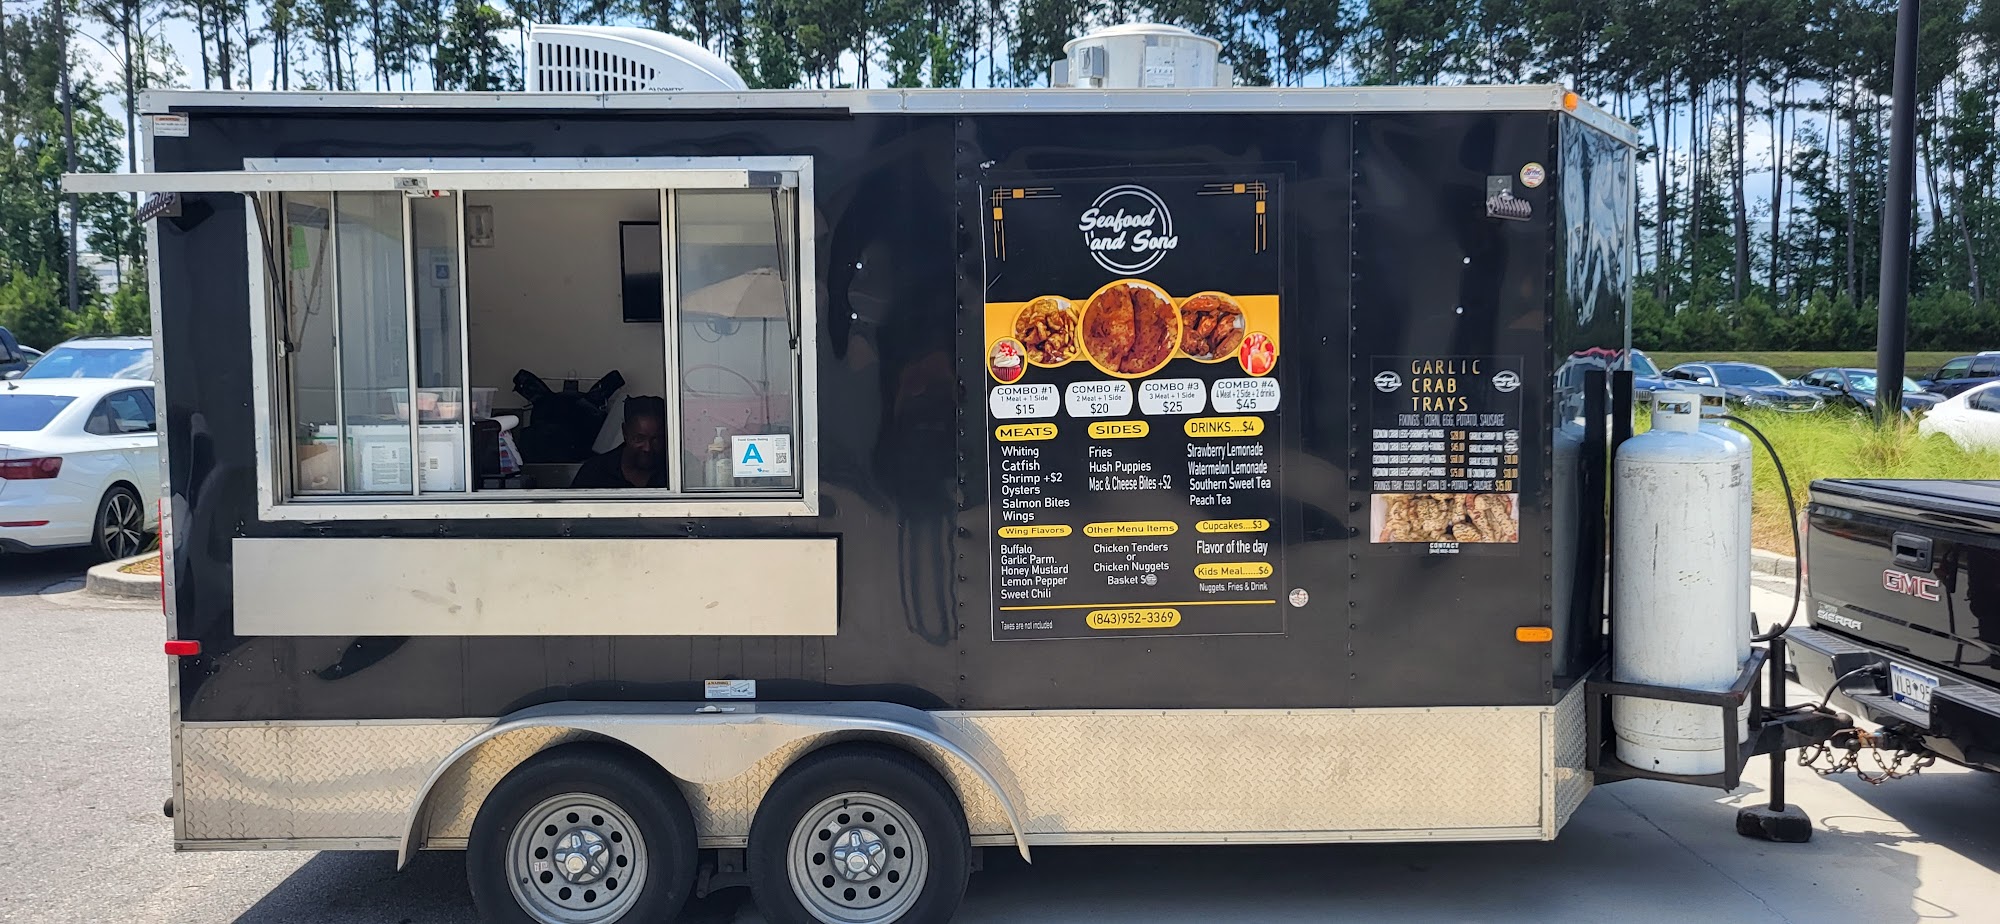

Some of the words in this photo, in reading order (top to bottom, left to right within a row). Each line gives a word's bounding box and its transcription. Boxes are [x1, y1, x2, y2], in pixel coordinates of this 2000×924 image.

[1079, 208, 1156, 232] Seafood
[1090, 231, 1126, 250] and
[1130, 229, 1178, 252] Sons
[1412, 360, 1480, 374] GARLIC
[998, 387, 1038, 395] COMBO
[1072, 385, 1111, 393] COMBO
[1145, 383, 1184, 391] COMBO
[1218, 381, 1257, 389] COMBO
[1412, 378, 1456, 393] CRAB
[1015, 404, 1035, 415] $15
[1090, 403, 1108, 415] $20
[1162, 401, 1182, 413] $25
[1236, 399, 1257, 410] $45
[1412, 397, 1468, 412] TRAYS
[1480, 414, 1504, 426] SAUSAGE
[1000, 427, 1053, 437] MEATS
[1096, 425, 1142, 434] SIDES
[742, 444, 764, 463] A
[1001, 446, 1039, 458] Whiting
[1089, 446, 1112, 458] Fries
[1187, 442, 1225, 460] Strawberry
[1227, 442, 1263, 456] Lemonade
[1002, 460, 1040, 471] Catfish
[1089, 461, 1112, 472] Hush
[1115, 460, 1151, 474] Puppies
[1188, 460, 1230, 475] Watermelon
[1231, 459, 1267, 474] Lemonade
[1002, 474, 1040, 485] Shrimp
[1044, 472, 1062, 483] +$2
[1089, 477, 1103, 491] Mac
[1105, 476, 1110, 490] &
[1112, 476, 1137, 490] Cheese
[1139, 475, 1156, 490] Bites
[1190, 478, 1227, 490] Southern
[1229, 477, 1254, 489] Sweet
[1256, 476, 1271, 488] Tea
[1002, 485, 1040, 497] Oysters
[1003, 499, 1041, 508] Salmon
[1045, 497, 1070, 507] Bites
[1190, 494, 1214, 505] Peach
[1216, 494, 1232, 504] Tea
[1003, 511, 1034, 523] Wings
[1001, 544, 1032, 554] Buffalo
[1094, 544, 1129, 553] Chicken
[1132, 543, 1168, 552] Tenders
[1196, 540, 1224, 554] Flavor
[1226, 540, 1235, 553] of
[1236, 540, 1250, 553] the
[1253, 539, 1268, 556] day
[1001, 555, 1027, 564] Garlic
[1030, 555, 1057, 564] Parm.
[1001, 566, 1029, 577] Honey
[1032, 564, 1069, 574] Mustard
[1094, 563, 1129, 572] Chicken
[1132, 562, 1169, 572] Nuggets
[1002, 577, 1032, 586] Lemon
[1036, 576, 1068, 587] Pepper
[1108, 575, 1138, 584] Basket
[1882, 569, 1940, 601] GMC
[1228, 582, 1243, 591] Fries
[1244, 582, 1249, 590] &
[1251, 582, 1268, 590] Drink
[1001, 589, 1029, 599] Sweet
[1031, 588, 1051, 598] Chili
[1094, 612, 1173, 625] (843)952-3369
[1818, 610, 1862, 631] SIERRA
[1001, 621, 1015, 630] Taxes
[1033, 621, 1052, 629] included
